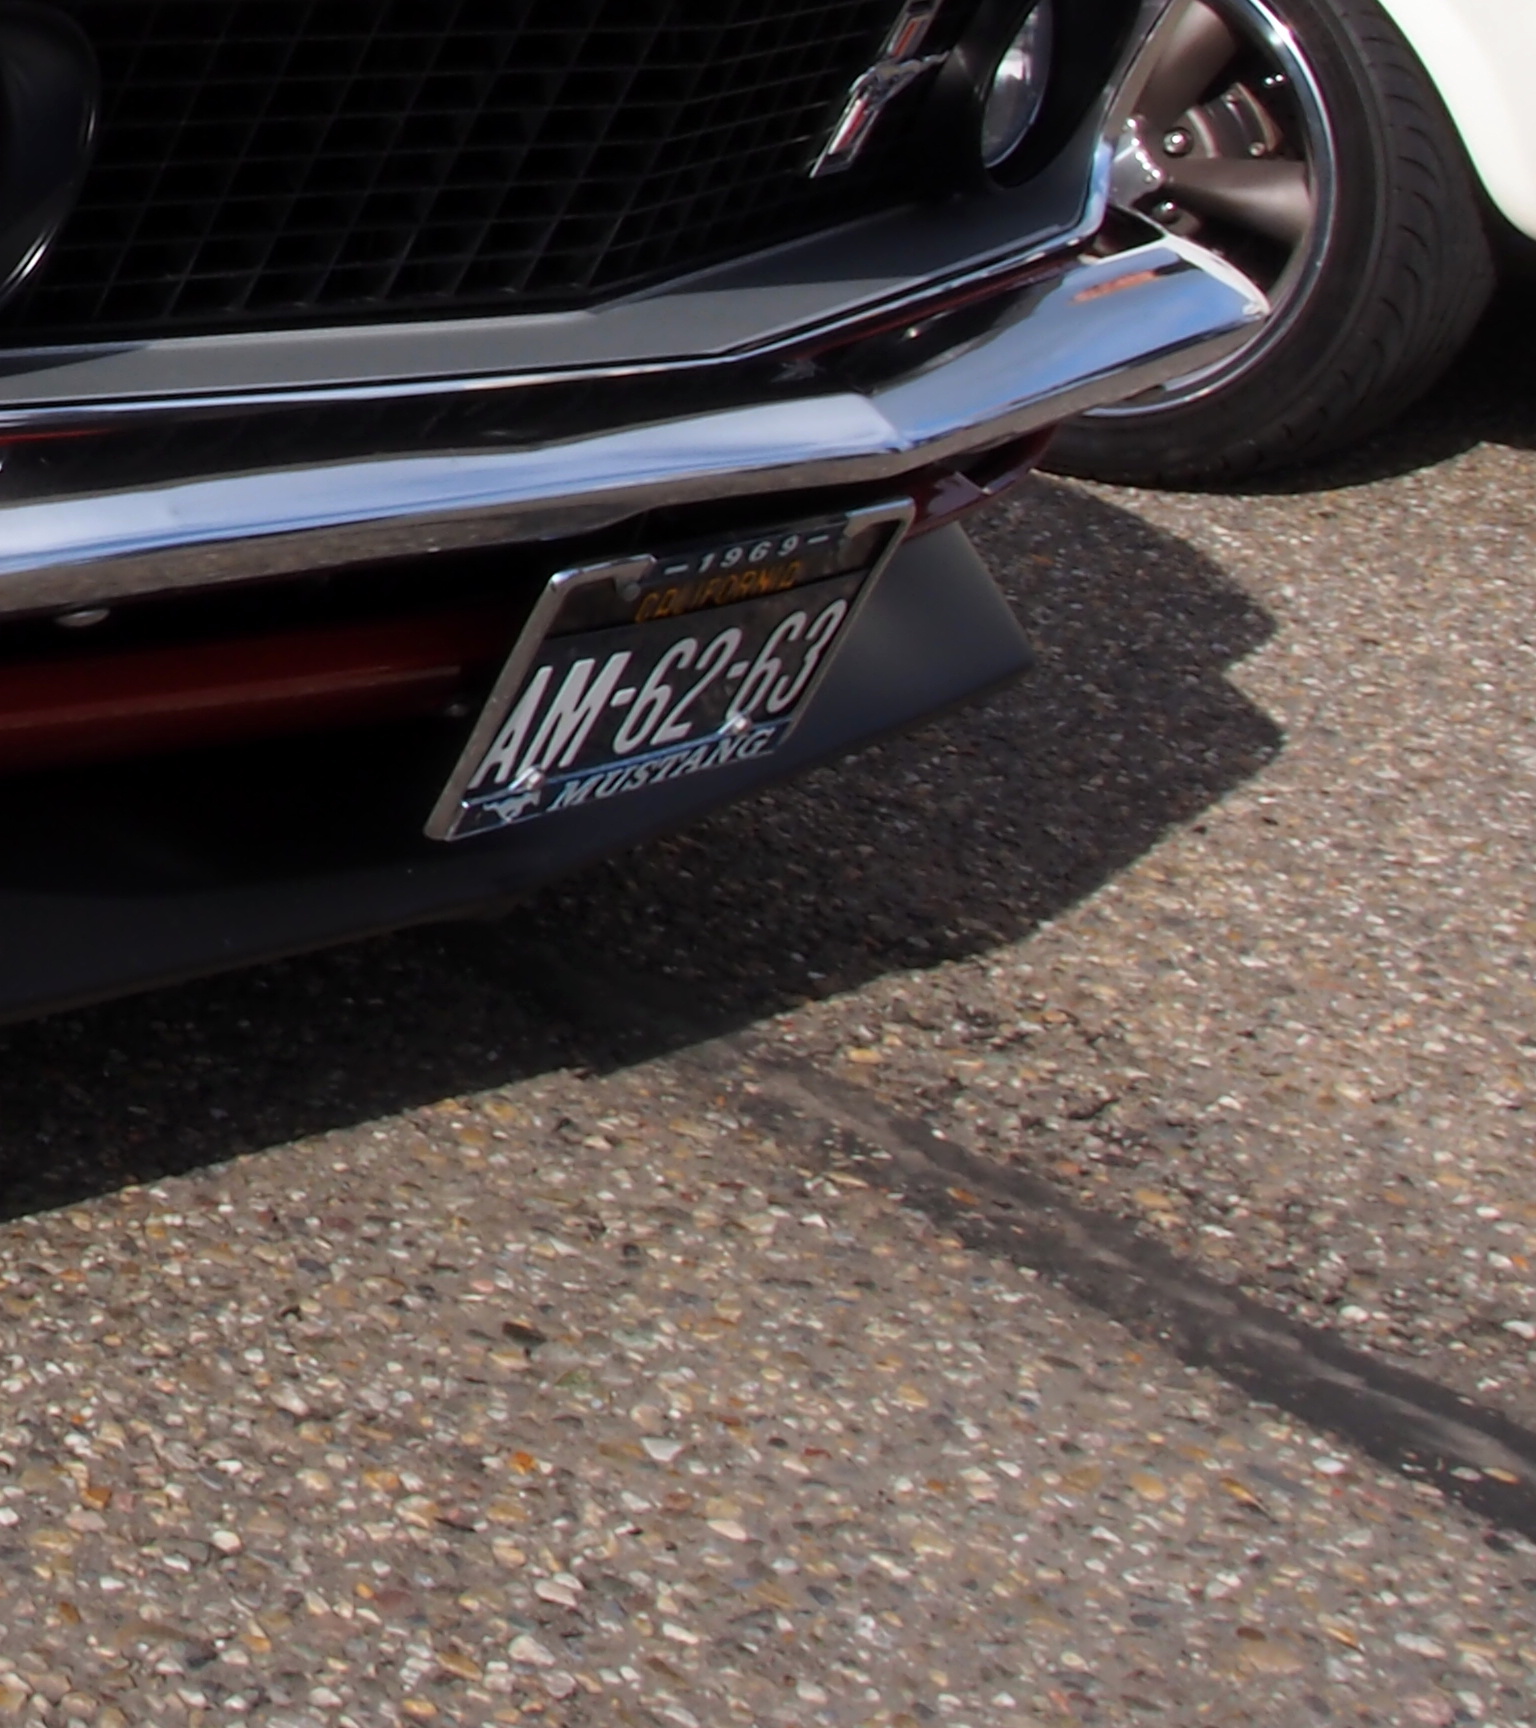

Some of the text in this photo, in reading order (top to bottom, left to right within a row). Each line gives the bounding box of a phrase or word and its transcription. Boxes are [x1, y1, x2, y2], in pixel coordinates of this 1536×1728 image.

[634, 560, 802, 623] CALIFORNIA
[468, 598, 848, 791] AM-62-63
[545, 726, 777, 812] MUSTANG
